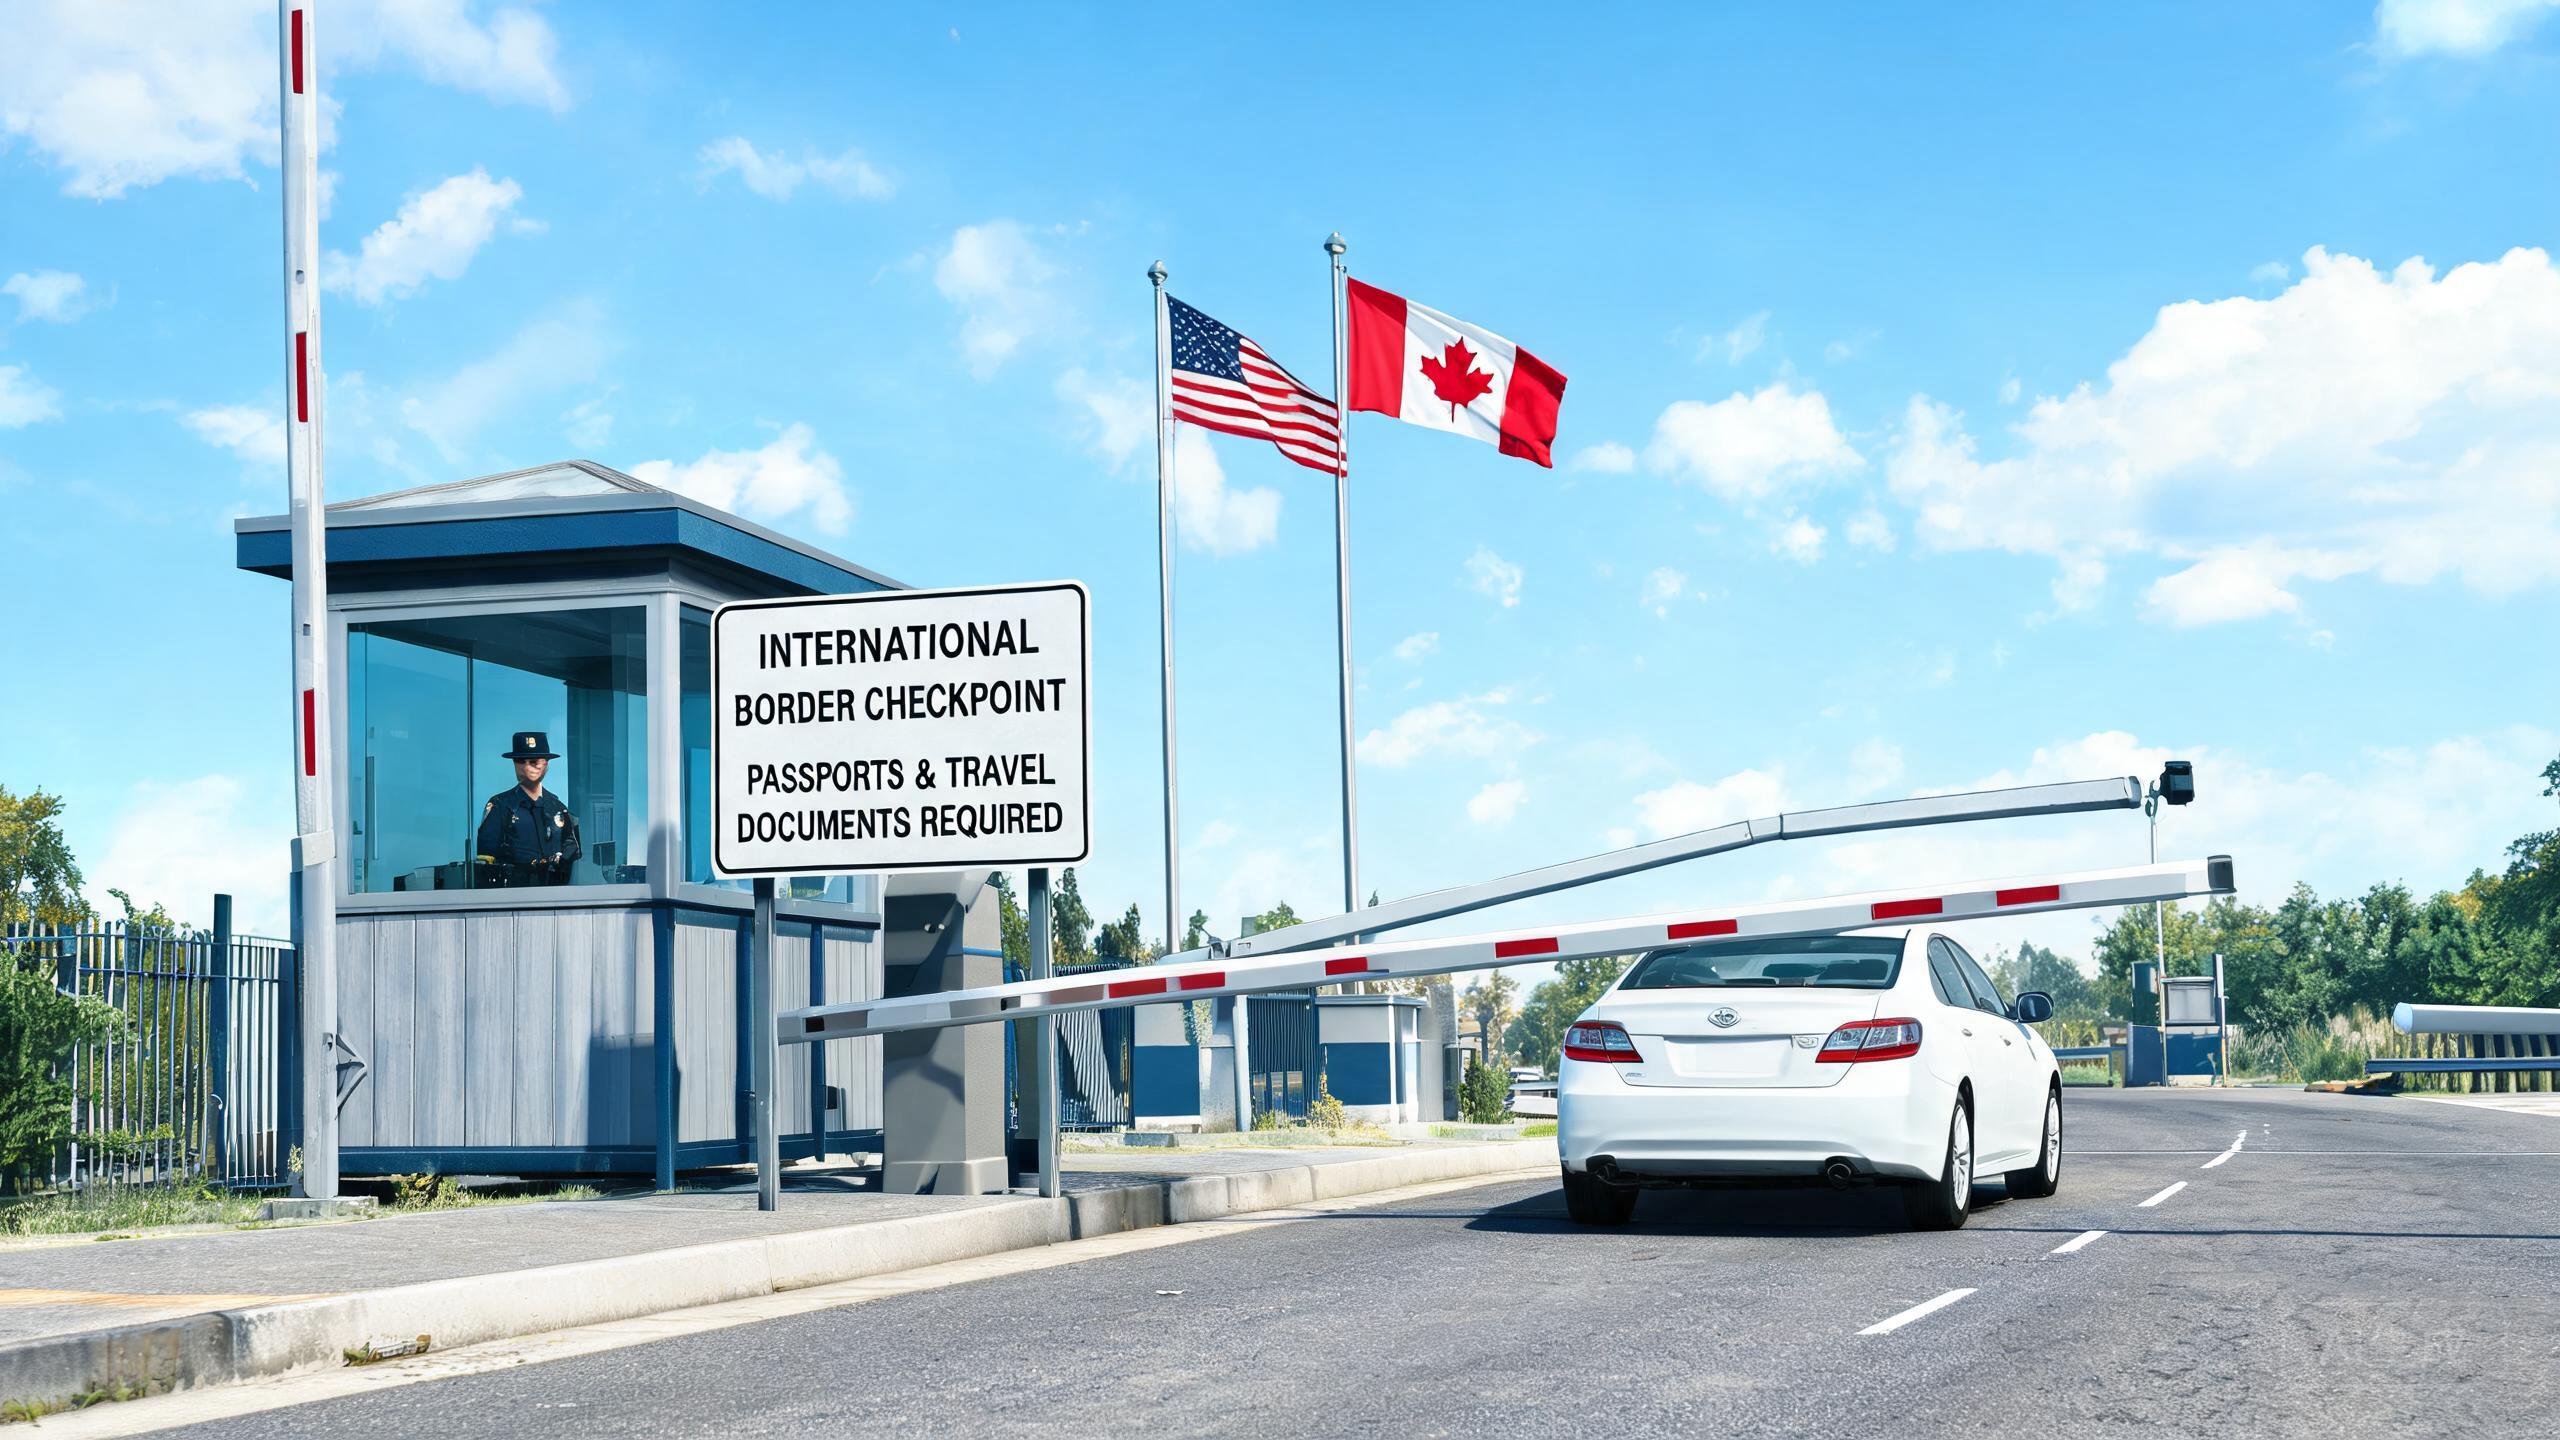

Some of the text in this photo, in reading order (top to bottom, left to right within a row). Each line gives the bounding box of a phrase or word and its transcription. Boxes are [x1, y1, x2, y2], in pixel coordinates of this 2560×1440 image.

[760, 619, 1039, 669] INTERNATIONAL
[735, 678, 1066, 726] BORDER CHECKPOINT
[748, 754, 1055, 795] PASSPORTS & TRAVEL
[738, 802, 1062, 843] DOCUMENTS REQUIRED
